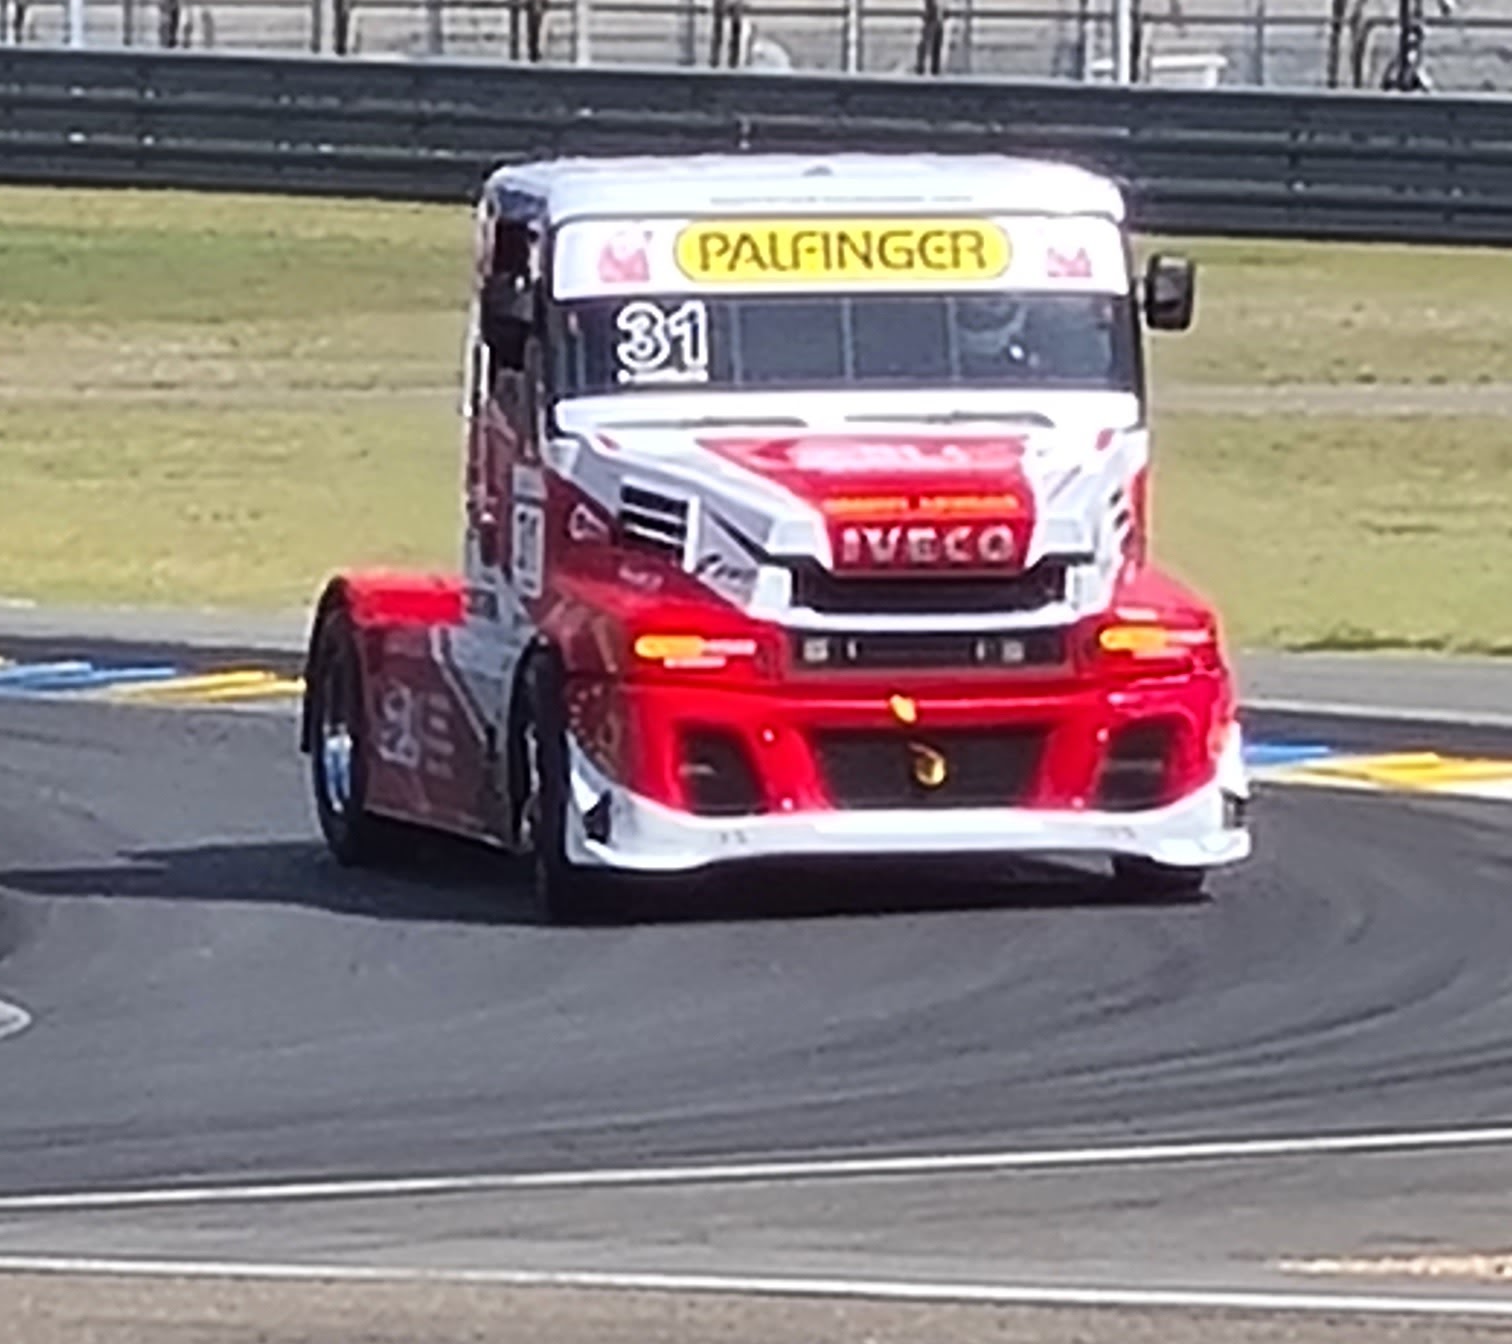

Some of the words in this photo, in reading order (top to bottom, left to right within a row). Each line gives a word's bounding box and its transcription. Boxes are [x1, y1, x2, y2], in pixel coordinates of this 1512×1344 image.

[697, 229, 987, 273] PALFINGER
[616, 299, 708, 371] 31
[841, 524, 1014, 563] IVECO
